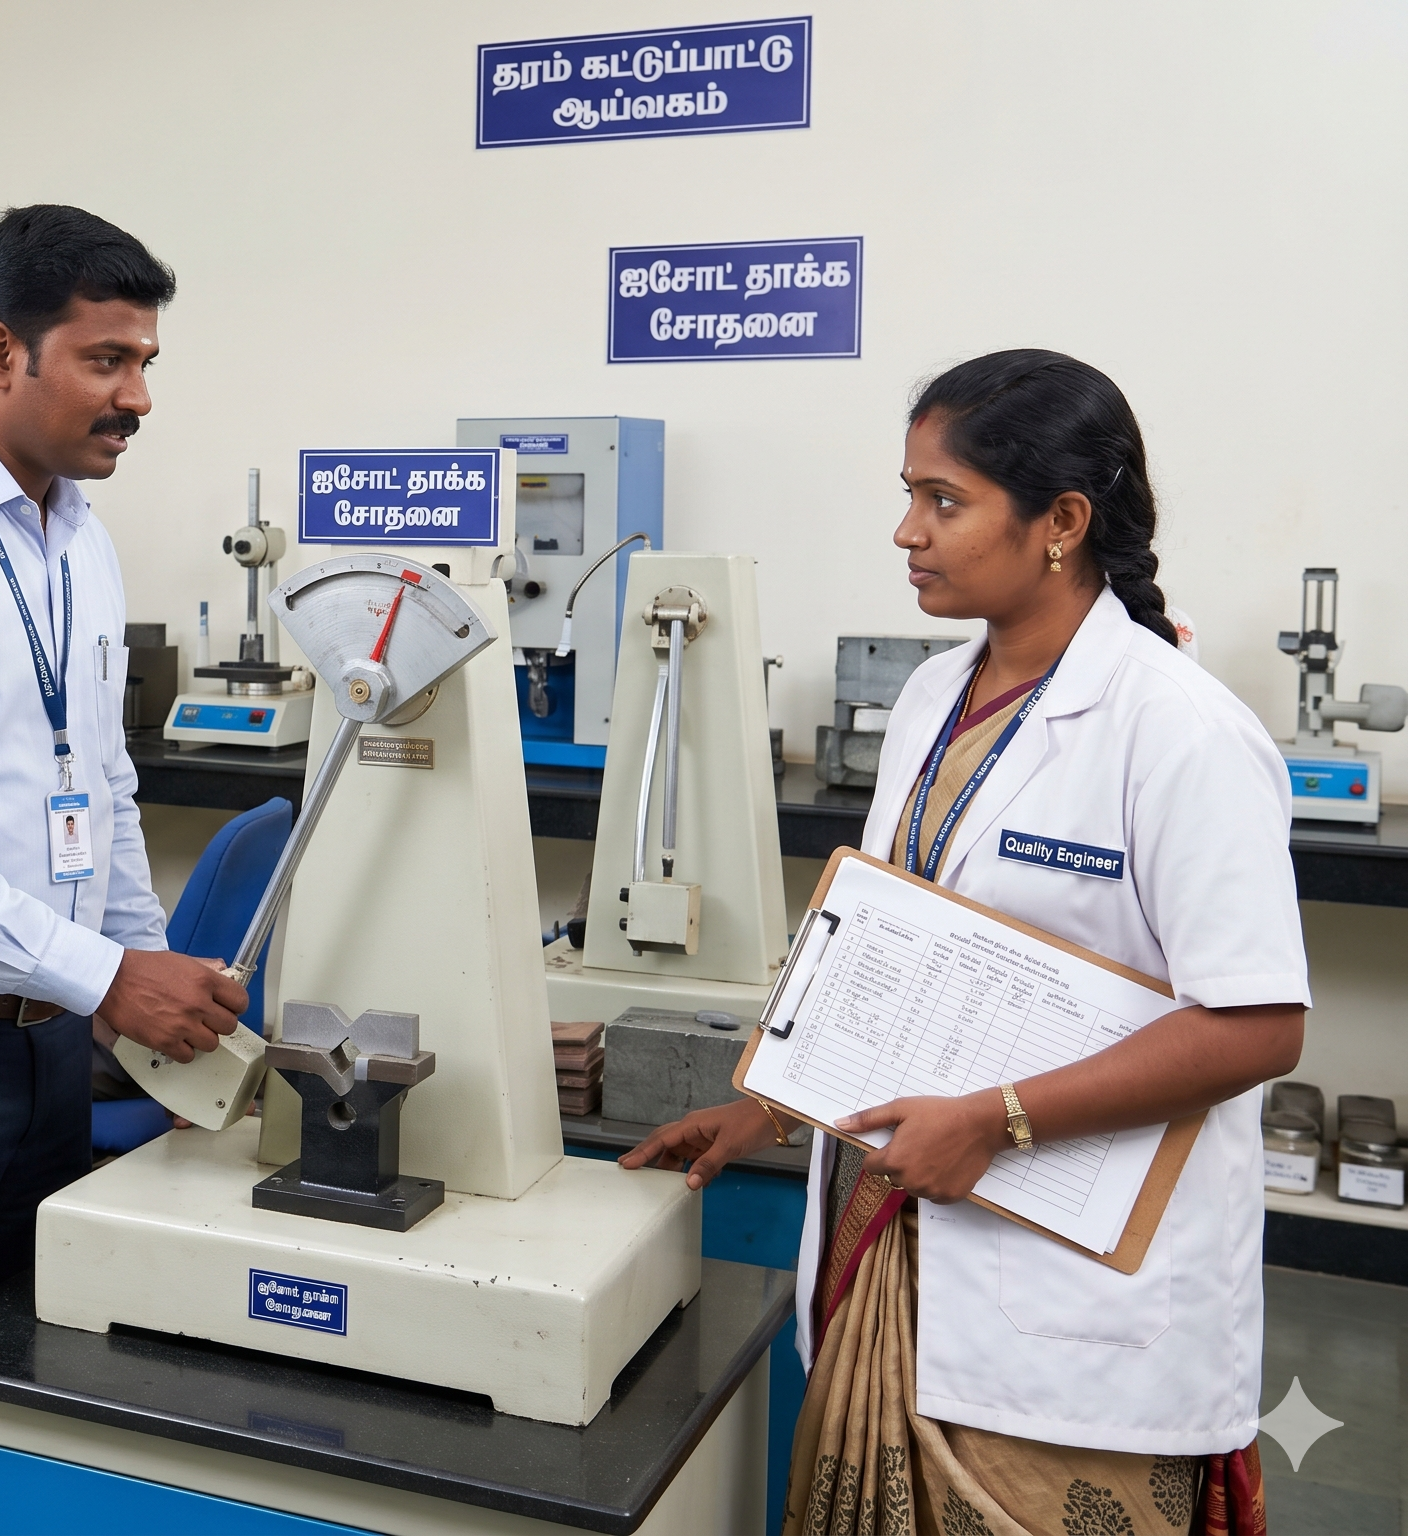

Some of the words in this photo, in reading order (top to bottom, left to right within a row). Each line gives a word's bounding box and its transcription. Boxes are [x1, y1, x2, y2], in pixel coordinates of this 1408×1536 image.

[492, 50, 572, 96] தரம்
[580, 34, 794, 83] கட்டுப்பாட்டு
[552, 81, 728, 130] ஆய்வகம்
[619, 259, 738, 298] ஐசோட்
[744, 252, 851, 301] தாக்க
[649, 307, 818, 349] சோதனை
[311, 463, 402, 494] ஐசோட்
[406, 462, 486, 499] தாக்க
[334, 499, 461, 535] சோதனை
[1005, 836, 1054, 863] Quality
[1056, 846, 1120, 871] Engineer
